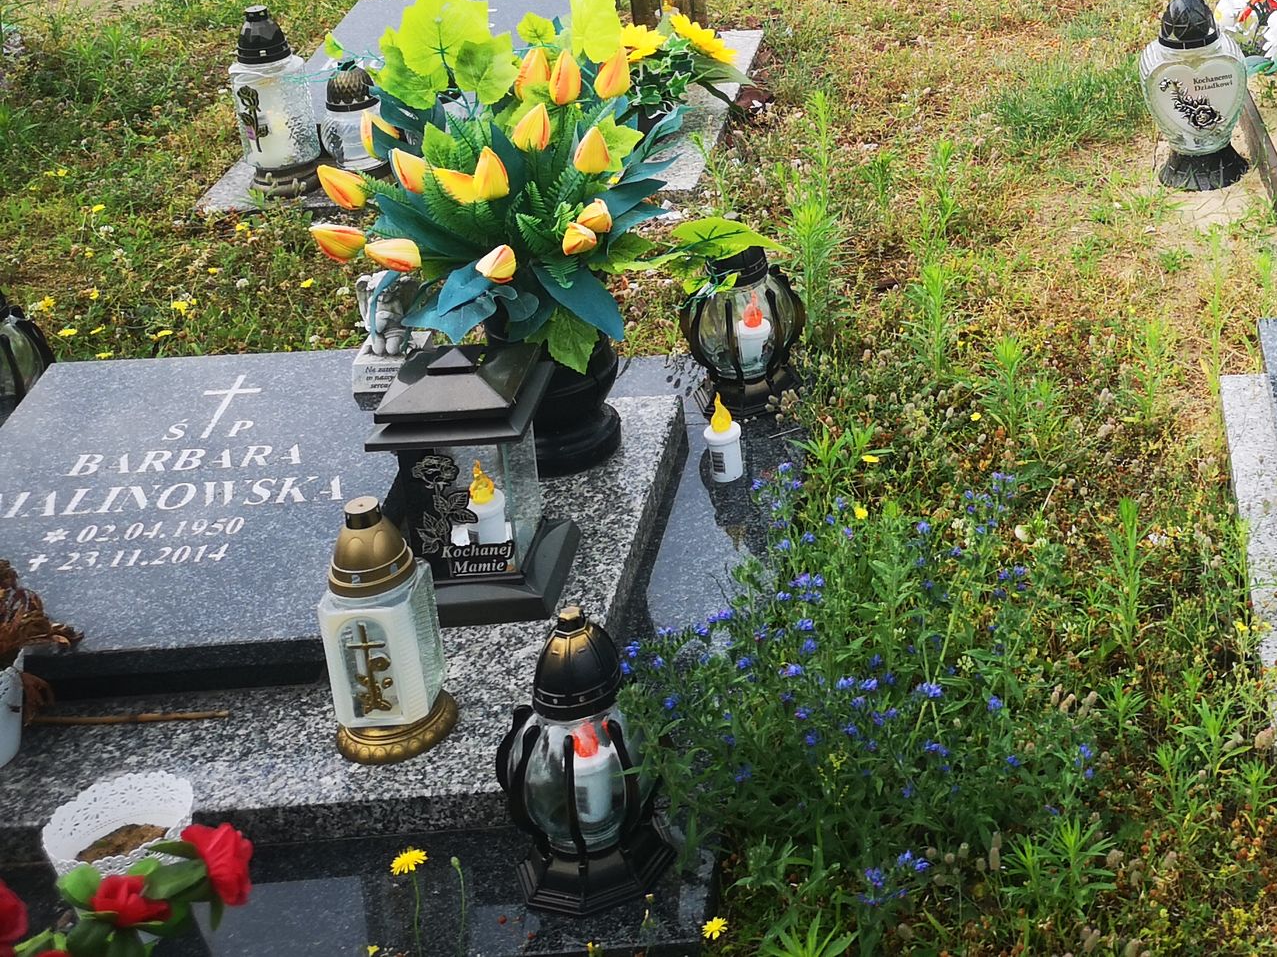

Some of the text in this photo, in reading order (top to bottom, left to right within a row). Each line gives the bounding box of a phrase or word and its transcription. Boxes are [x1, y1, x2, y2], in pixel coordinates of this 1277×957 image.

[1193, 74, 1233, 85] Kochanemu
[1194, 80, 1233, 92] Dziadkowi
[161, 419, 254, 441] Ś P
[63, 443, 301, 477] BARBARA
[56, 543, 230, 571] 23.11.2014
[441, 542, 513, 559] Kochanej
[453, 559, 505, 574] Mamie
